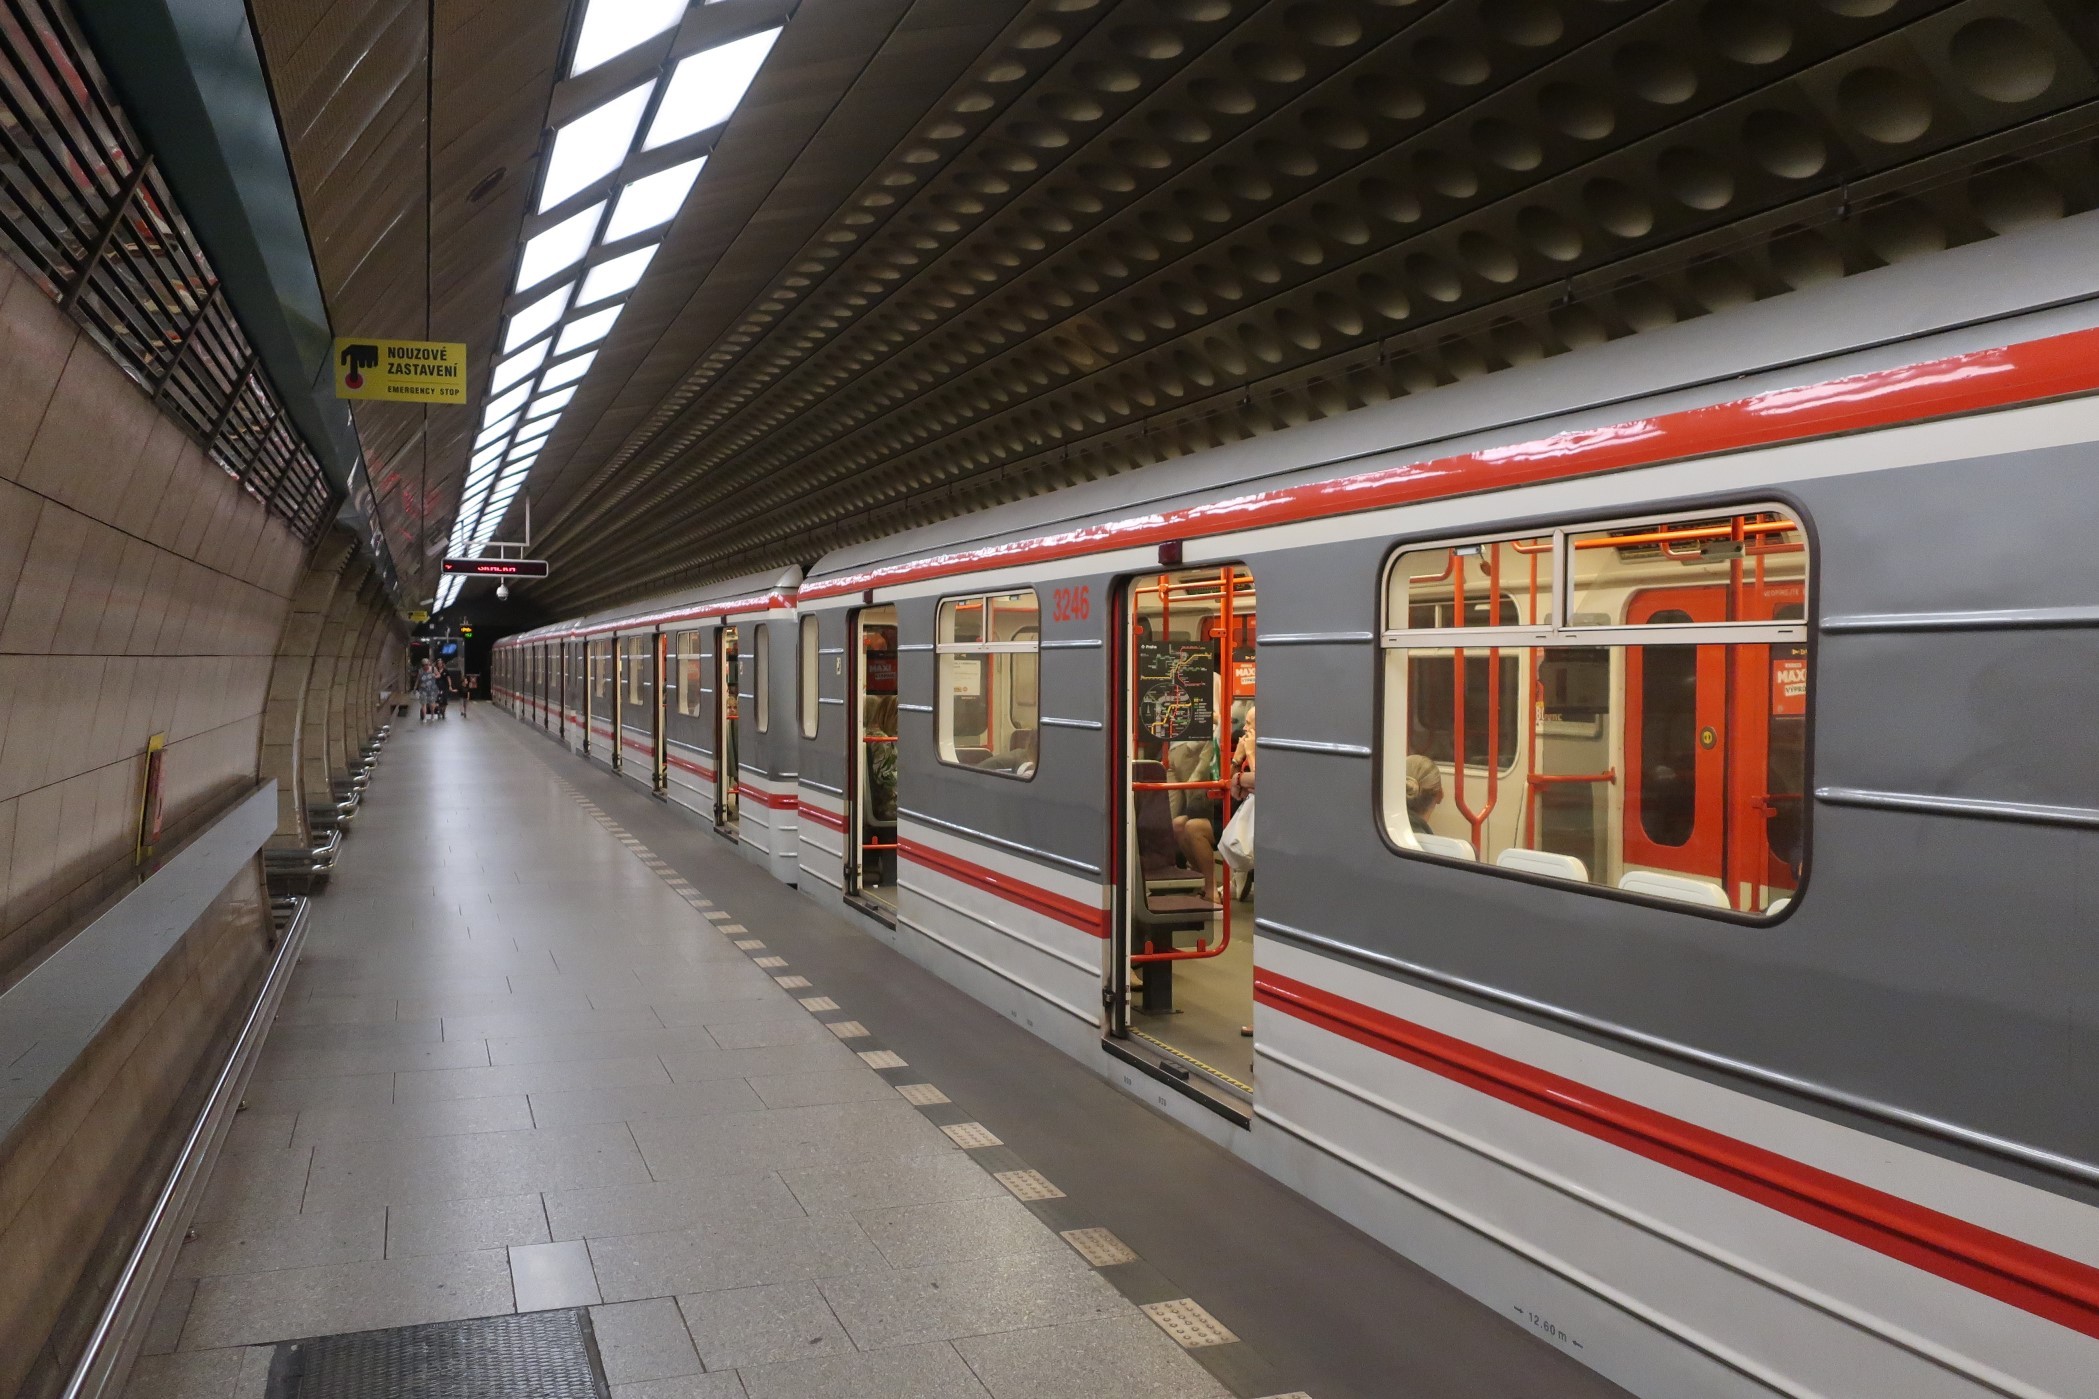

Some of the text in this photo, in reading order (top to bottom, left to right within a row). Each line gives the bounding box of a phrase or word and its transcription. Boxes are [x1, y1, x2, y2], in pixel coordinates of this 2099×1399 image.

[387, 346, 447, 361] NOUZOVÉ
[387, 362, 458, 377] ZASTAVENÍ
[387, 385, 460, 396] EMERGENCY STOP
[1053, 586, 1089, 621] 3246
[1528, 1312, 1567, 1342] 12.60 m
